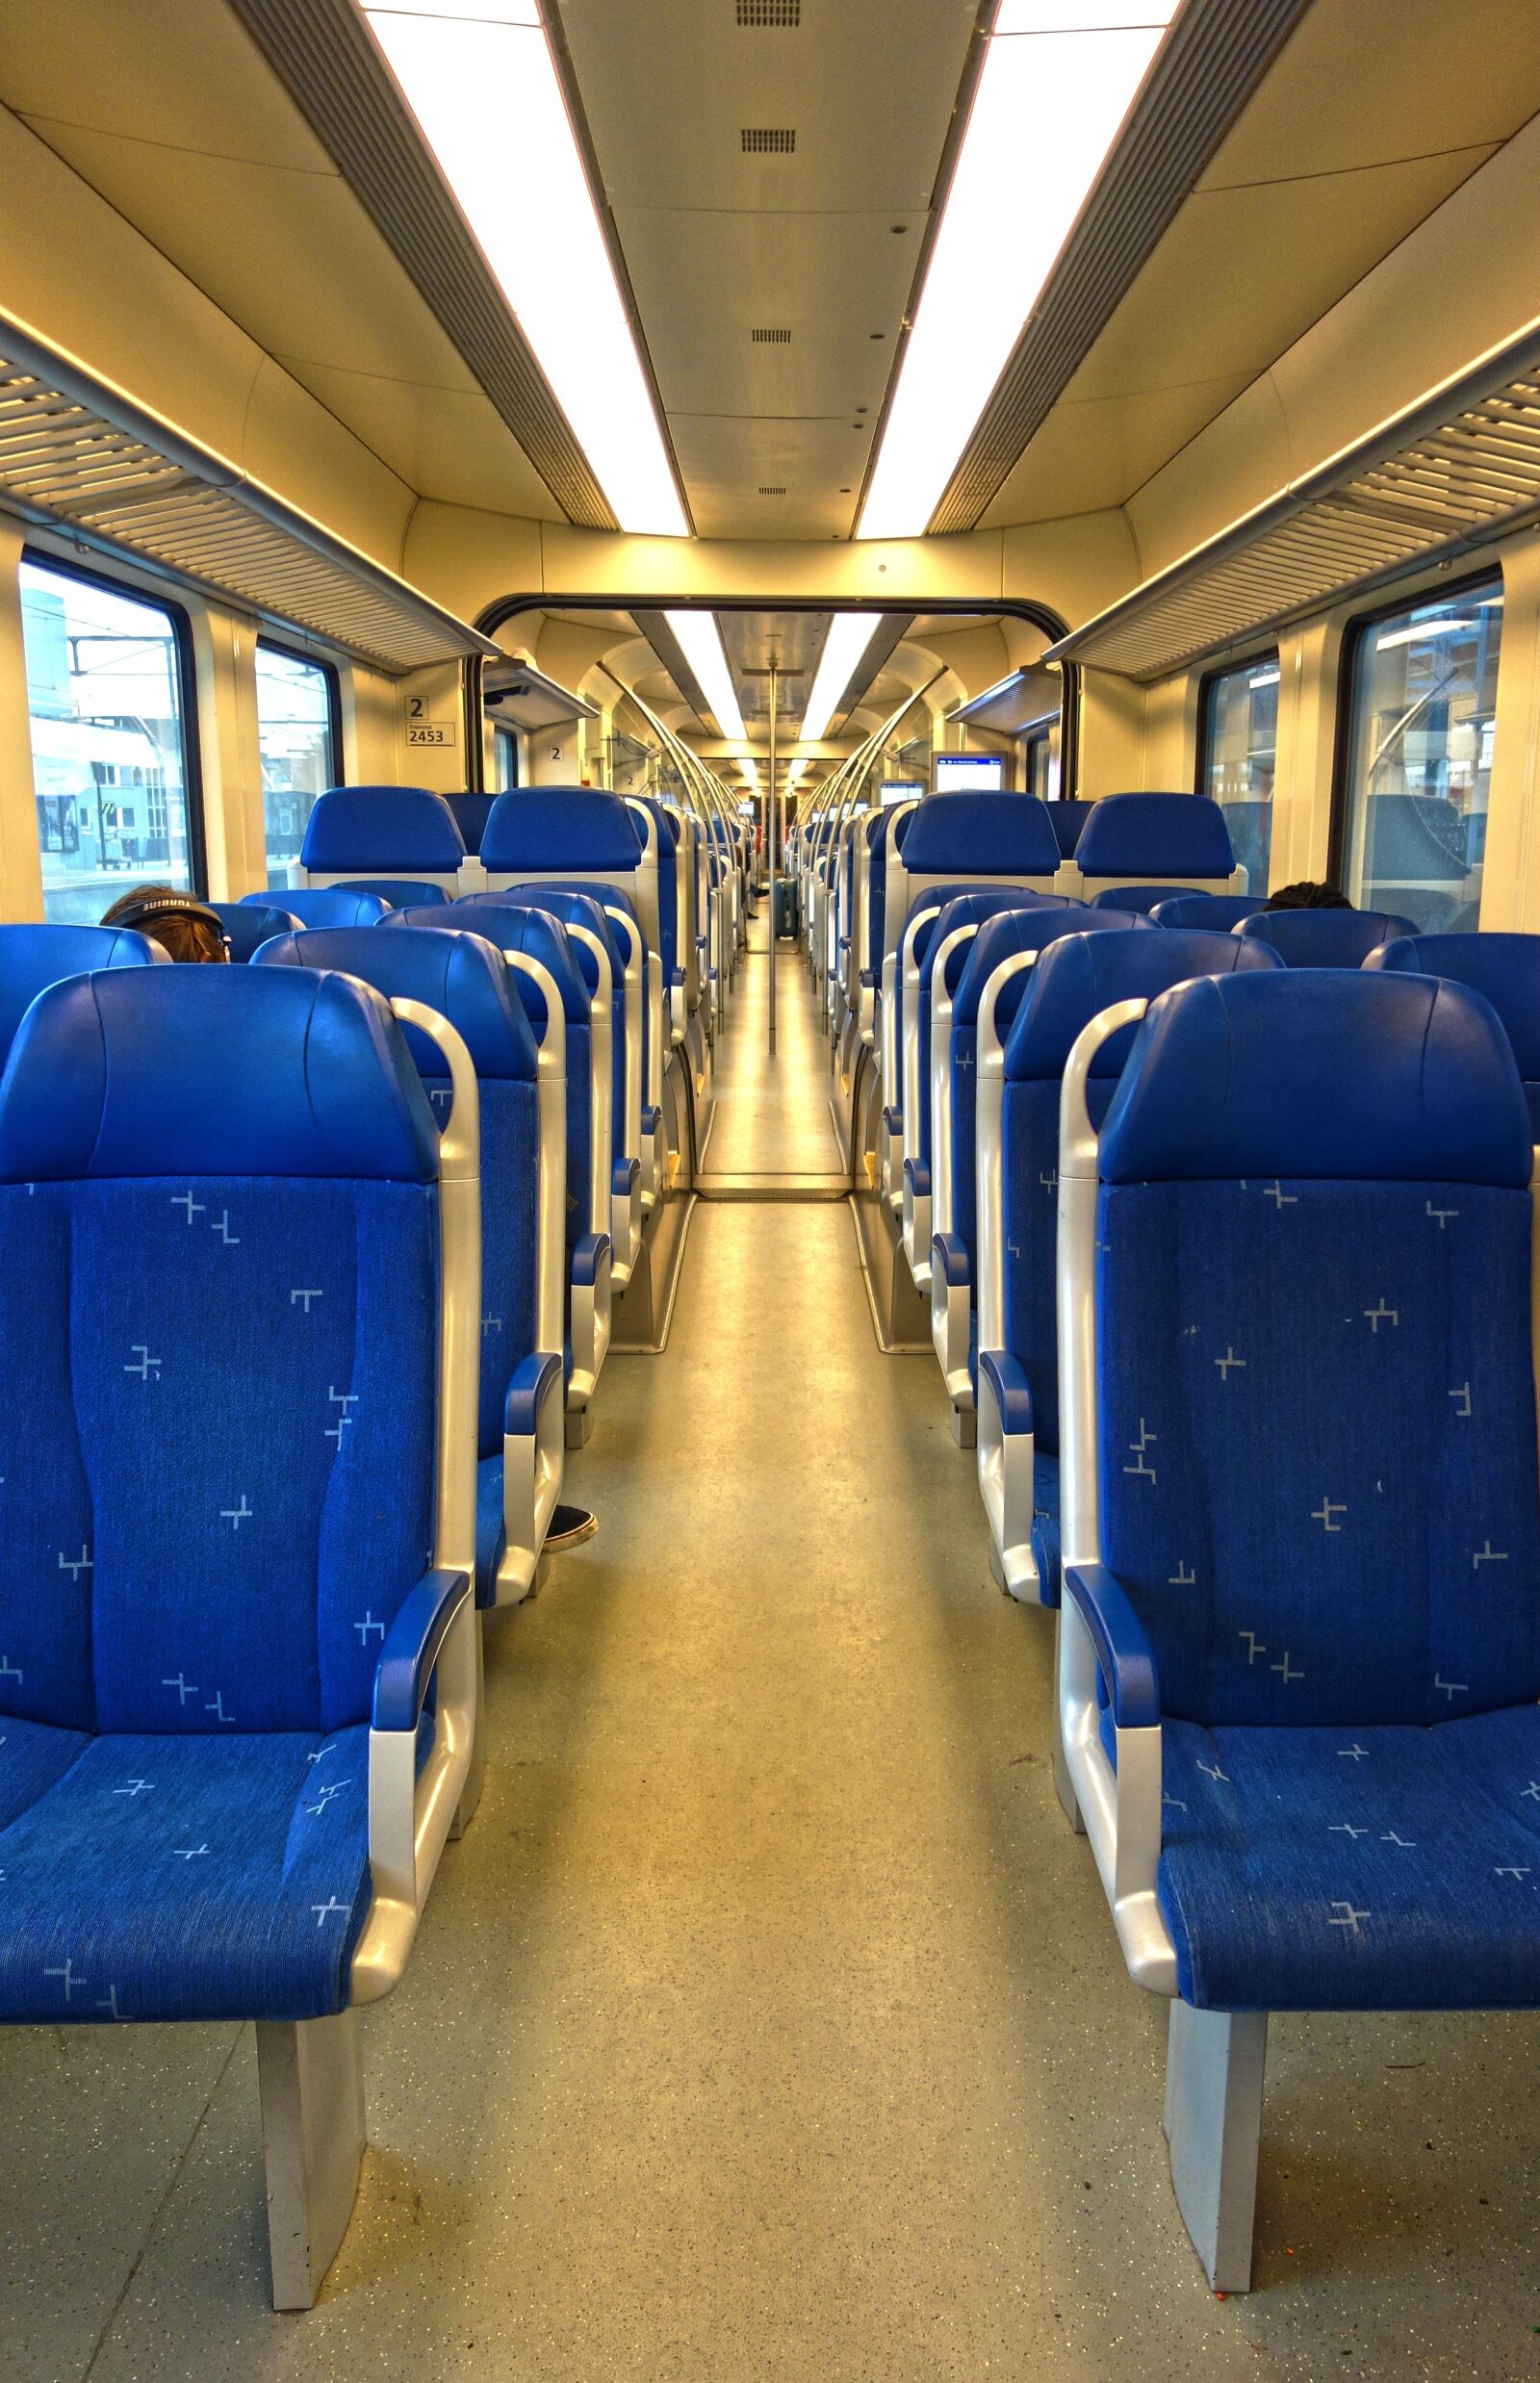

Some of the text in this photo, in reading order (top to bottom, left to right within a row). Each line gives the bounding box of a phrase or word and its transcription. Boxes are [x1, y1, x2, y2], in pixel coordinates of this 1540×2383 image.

[410, 698, 424, 718] 2
[409, 730, 444, 743] 2453
[552, 747, 560, 760] 2
[627, 777, 633, 785] 2
